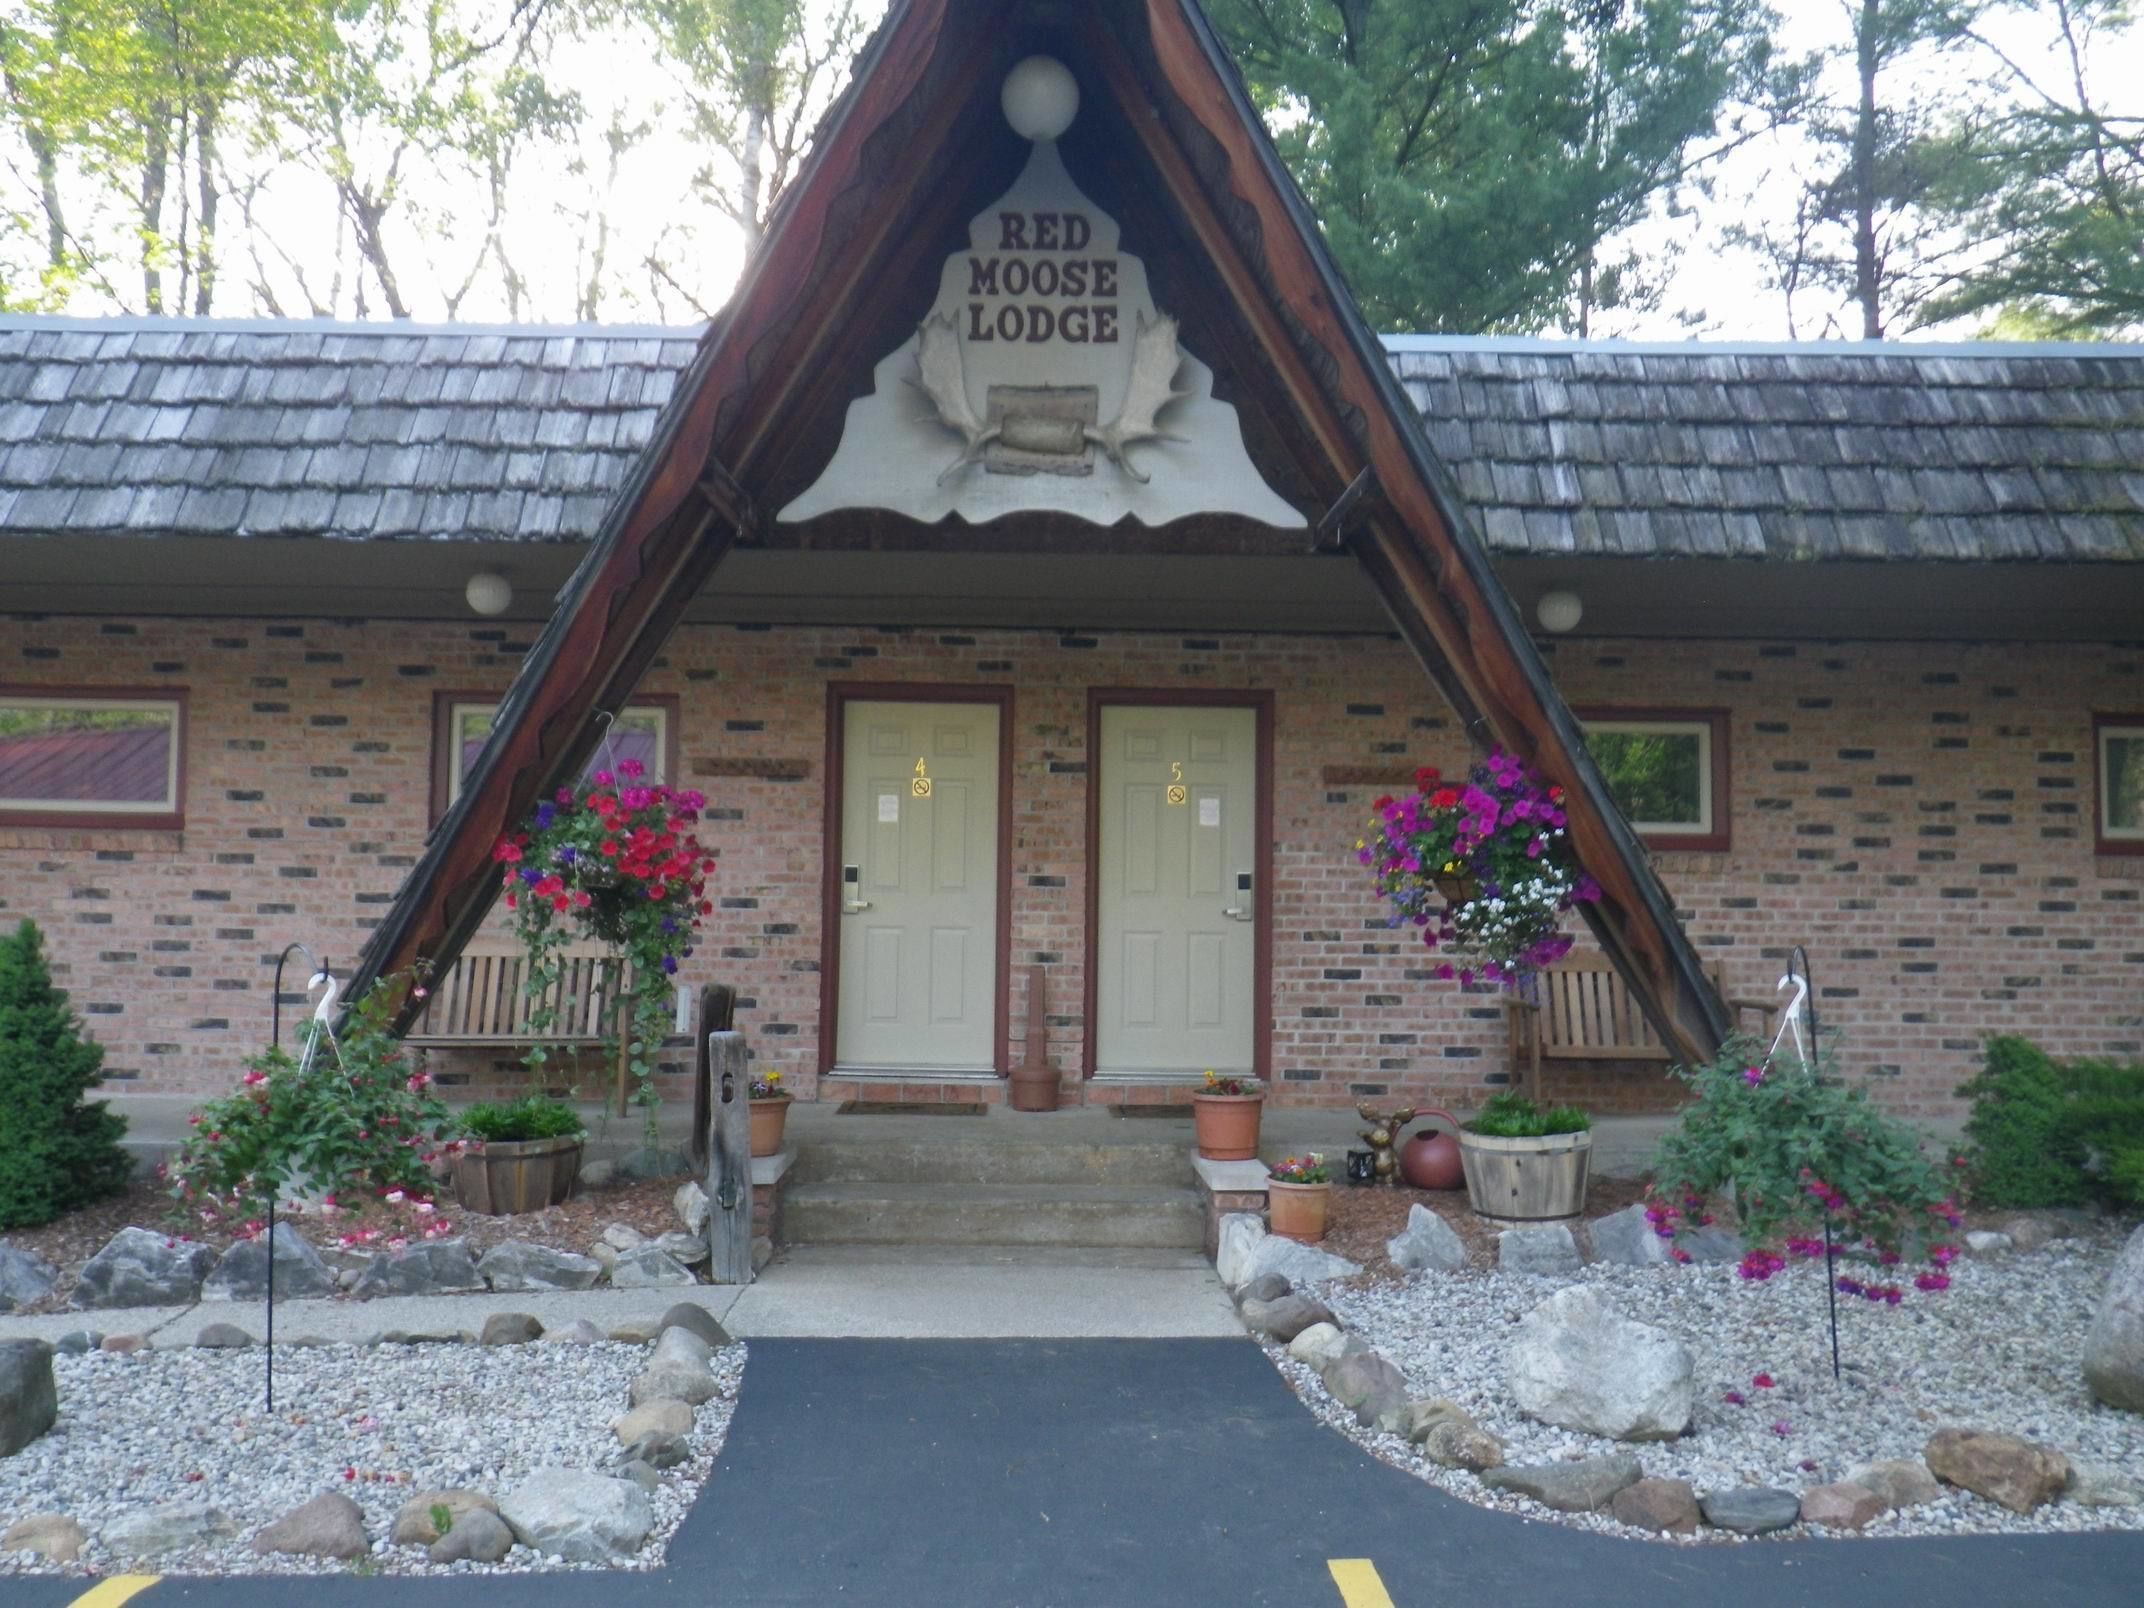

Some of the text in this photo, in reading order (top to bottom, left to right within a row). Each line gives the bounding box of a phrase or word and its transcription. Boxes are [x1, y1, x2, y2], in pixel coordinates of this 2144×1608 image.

[999, 212, 1091, 250] RED
[968, 257, 1117, 297] MOOSE
[968, 302, 1118, 343] LODGE
[915, 757, 926, 777] 4
[1171, 762, 1182, 781] 5
